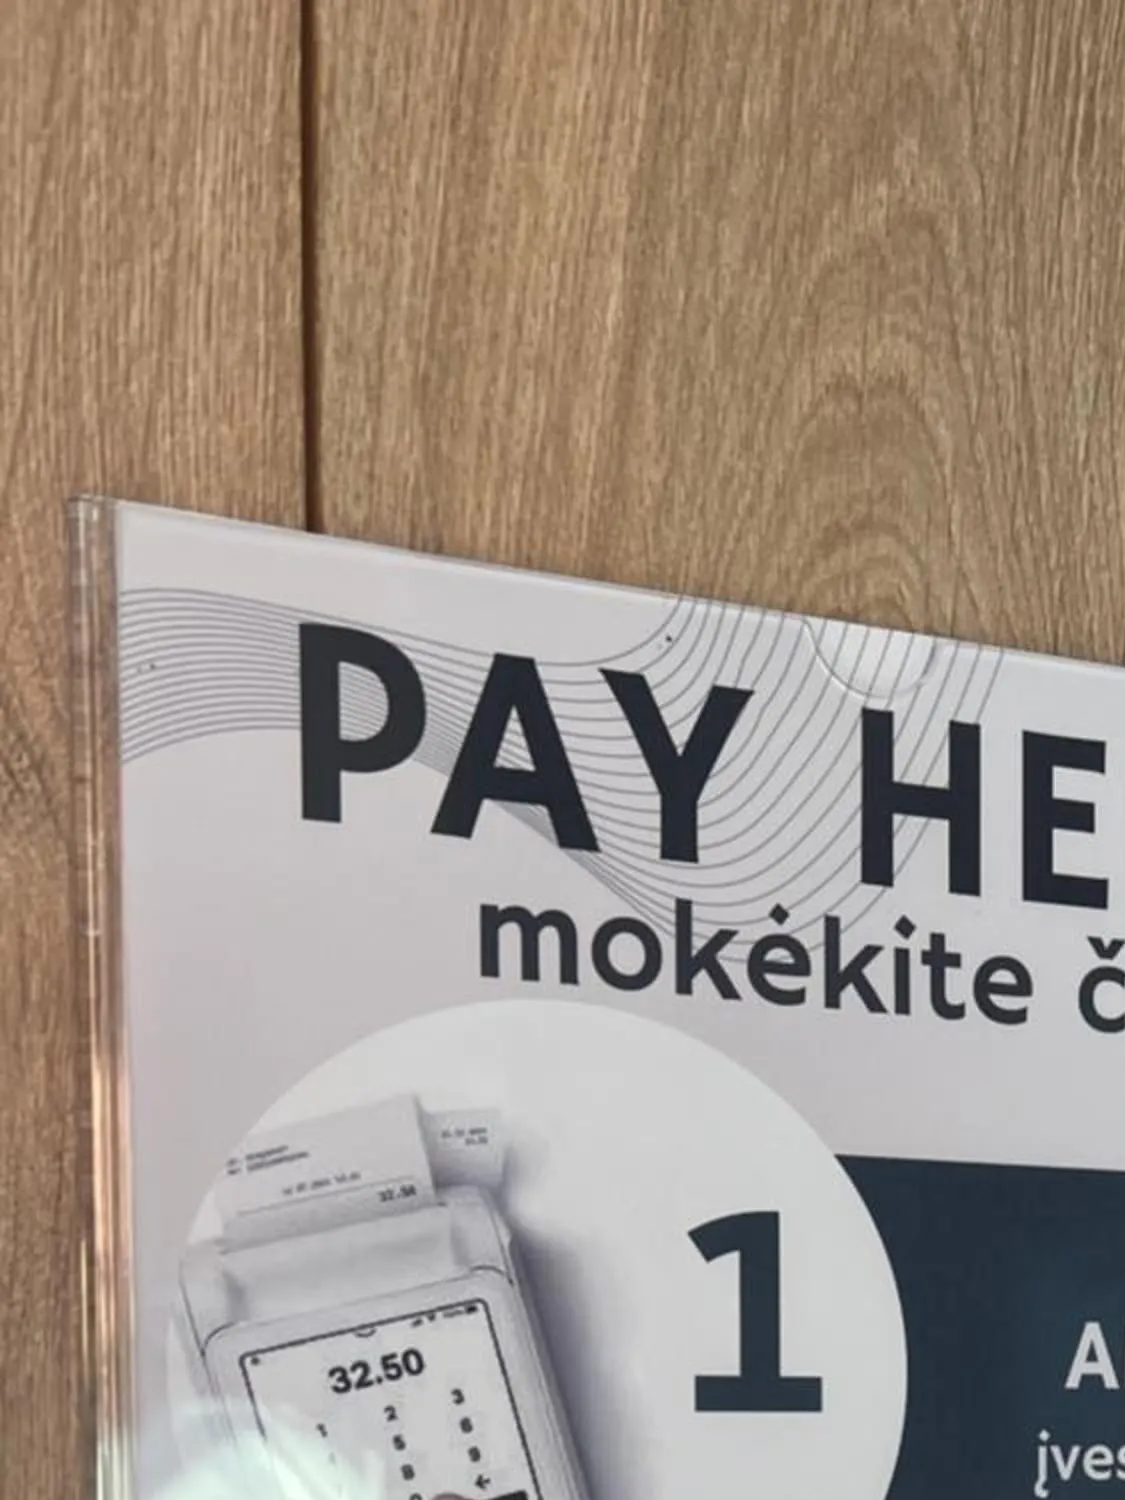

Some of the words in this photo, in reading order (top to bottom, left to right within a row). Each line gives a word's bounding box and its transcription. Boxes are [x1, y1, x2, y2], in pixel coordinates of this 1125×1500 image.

[299, 622, 754, 863] PAY
[479, 898, 1034, 1025] mokėkite
[327, 1347, 425, 1395] 32.50
[687, 1209, 823, 1413] 1
[383, 1404, 398, 1423] 2
[451, 1387, 466, 1406] 3
